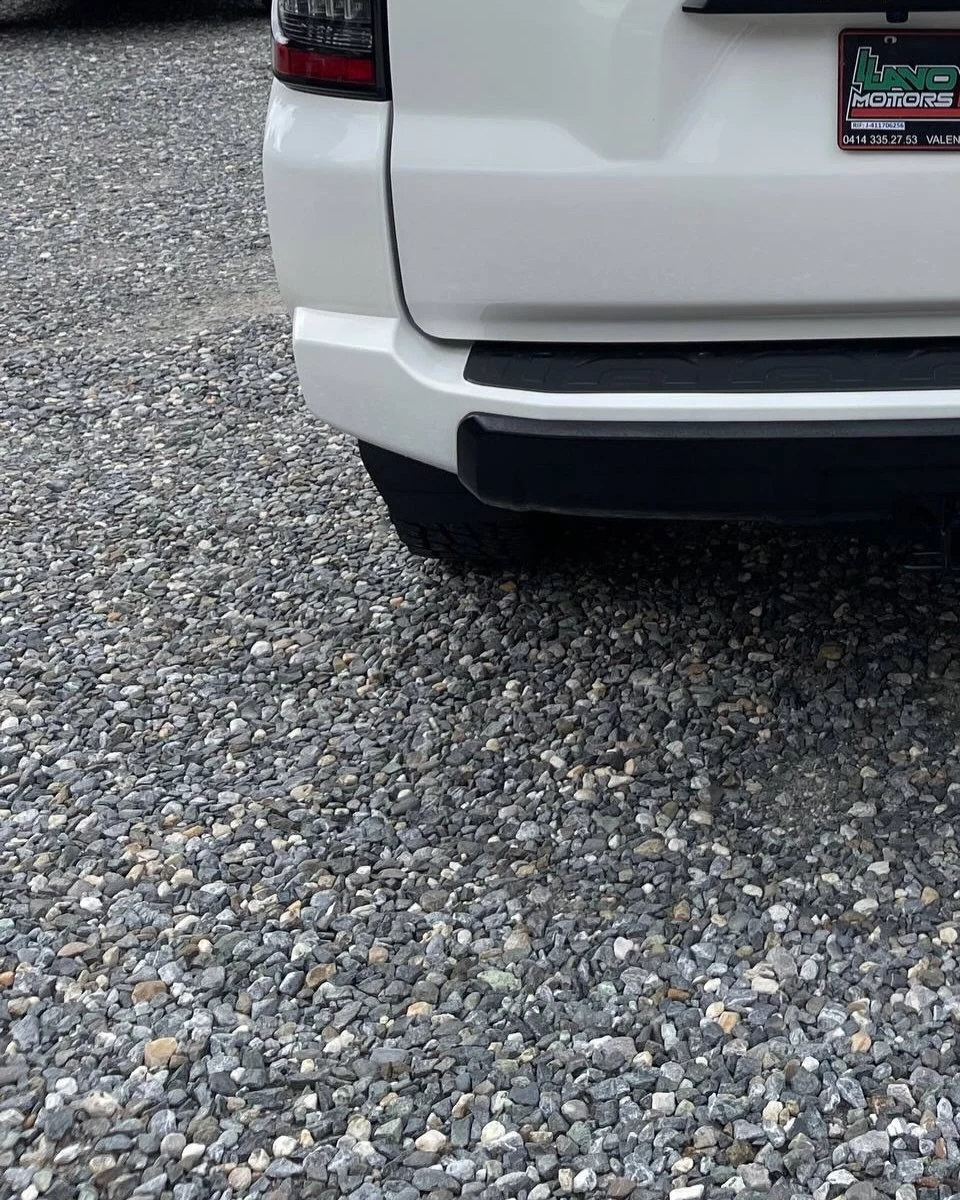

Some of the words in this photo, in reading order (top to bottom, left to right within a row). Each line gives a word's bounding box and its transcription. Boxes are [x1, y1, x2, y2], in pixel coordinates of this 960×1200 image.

[852, 92, 954, 107] MOTORS
[843, 135, 867, 145] 0414
[870, 135, 918, 145] 335.27.53
